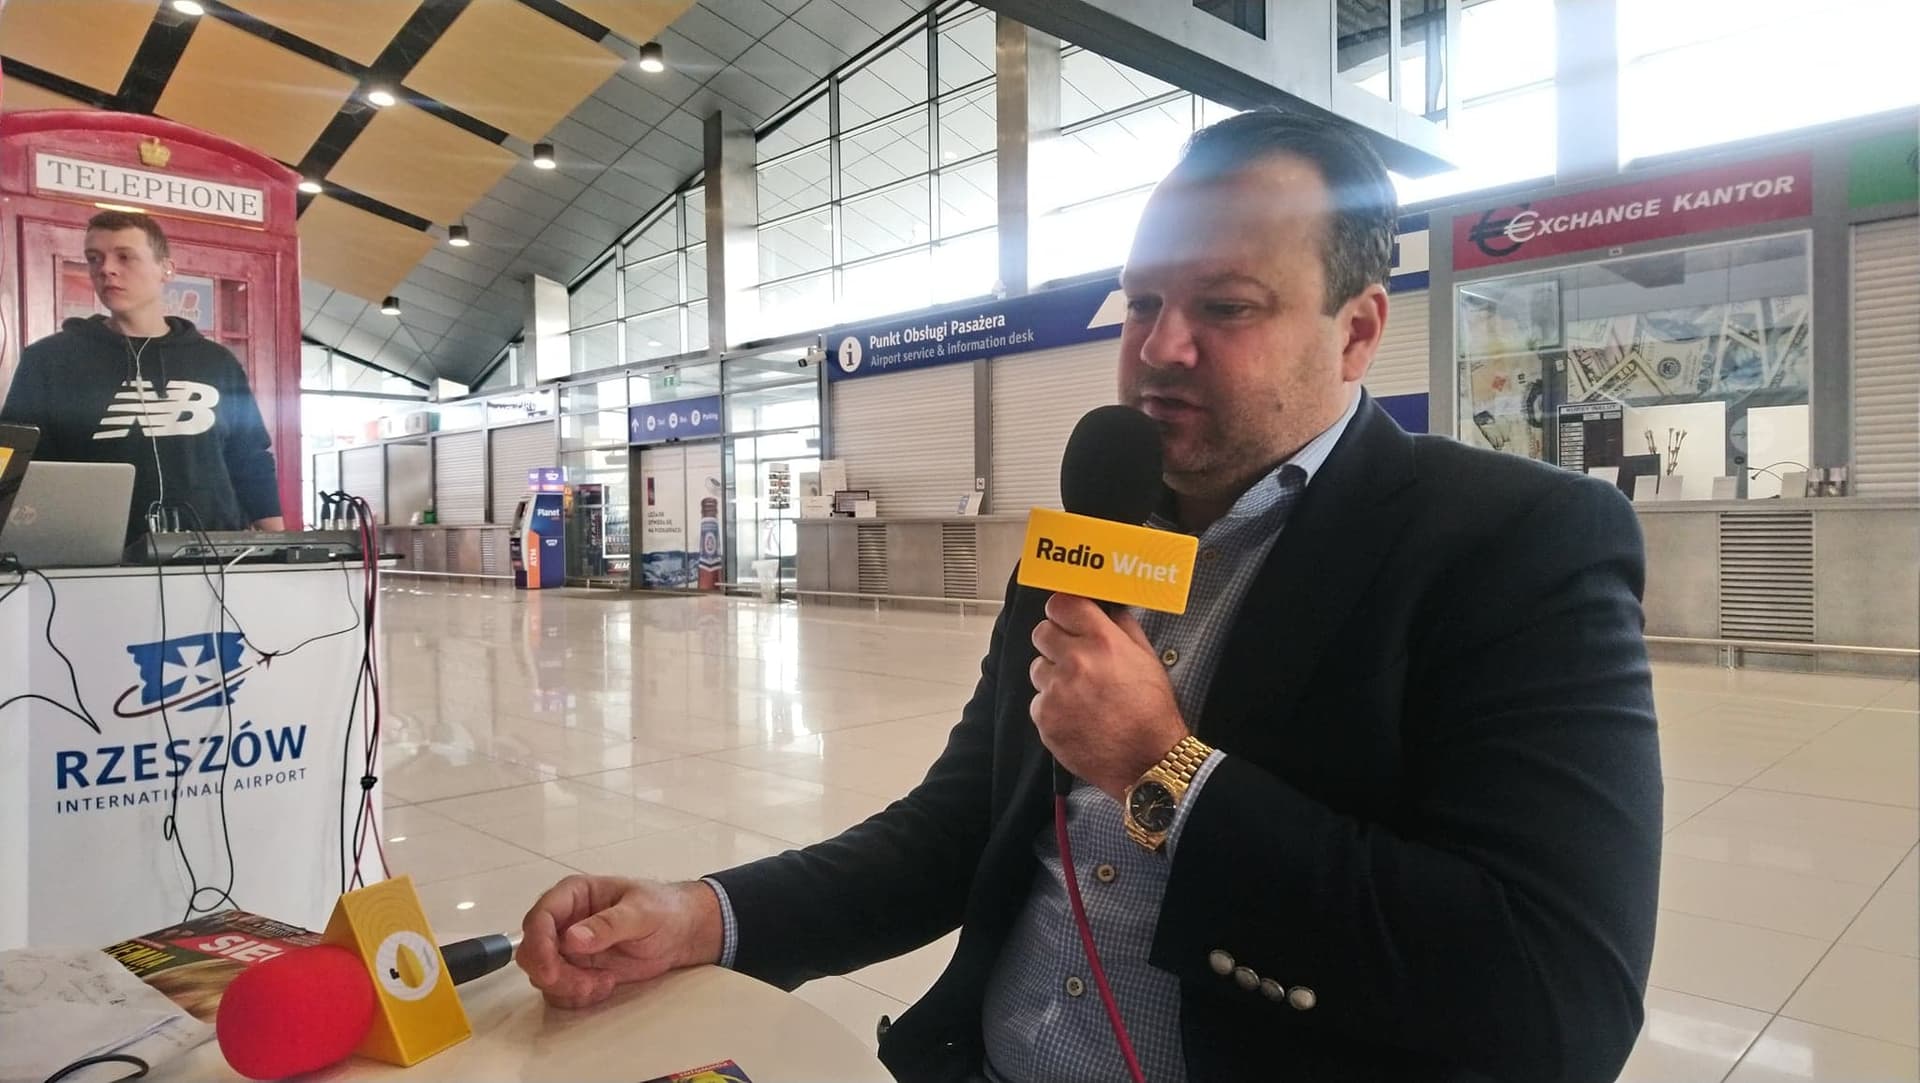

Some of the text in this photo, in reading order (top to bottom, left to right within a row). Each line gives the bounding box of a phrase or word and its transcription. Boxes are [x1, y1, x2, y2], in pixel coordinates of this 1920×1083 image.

[47, 160, 258, 217] TELEPHONE
[1673, 174, 1795, 213] KANTOR
[869, 314, 1006, 350] Punkt Obsługi Pasażera
[870, 328, 1035, 368] Airport service & information desk
[537, 508, 560, 517] Planet
[1035, 537, 1180, 585] Radio Wnet
[56, 720, 308, 790] RZESZÓW
[56, 767, 308, 814] INTERNATIONAL AIRPORT
